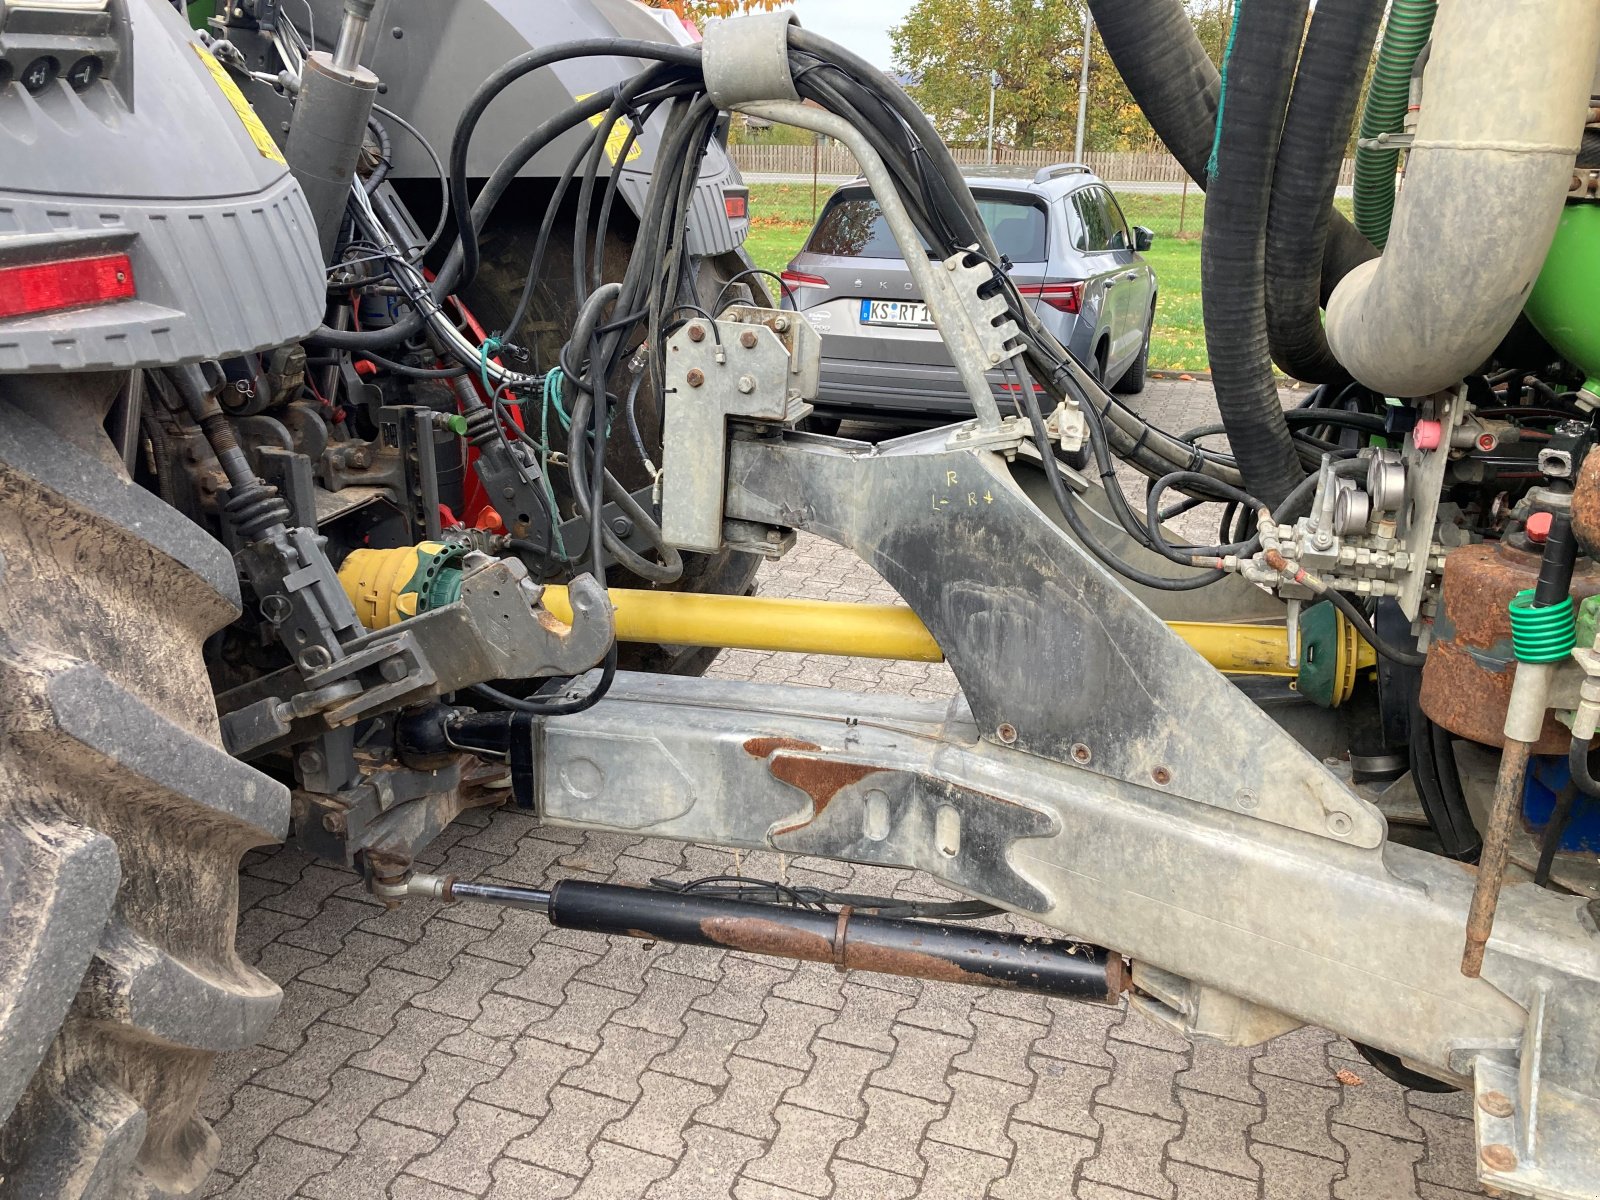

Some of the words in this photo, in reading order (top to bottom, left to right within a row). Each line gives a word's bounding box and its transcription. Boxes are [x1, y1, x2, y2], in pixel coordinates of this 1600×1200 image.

[871, 303, 889, 319] KS
[899, 304, 918, 321] RT
[947, 470, 958, 487] R
